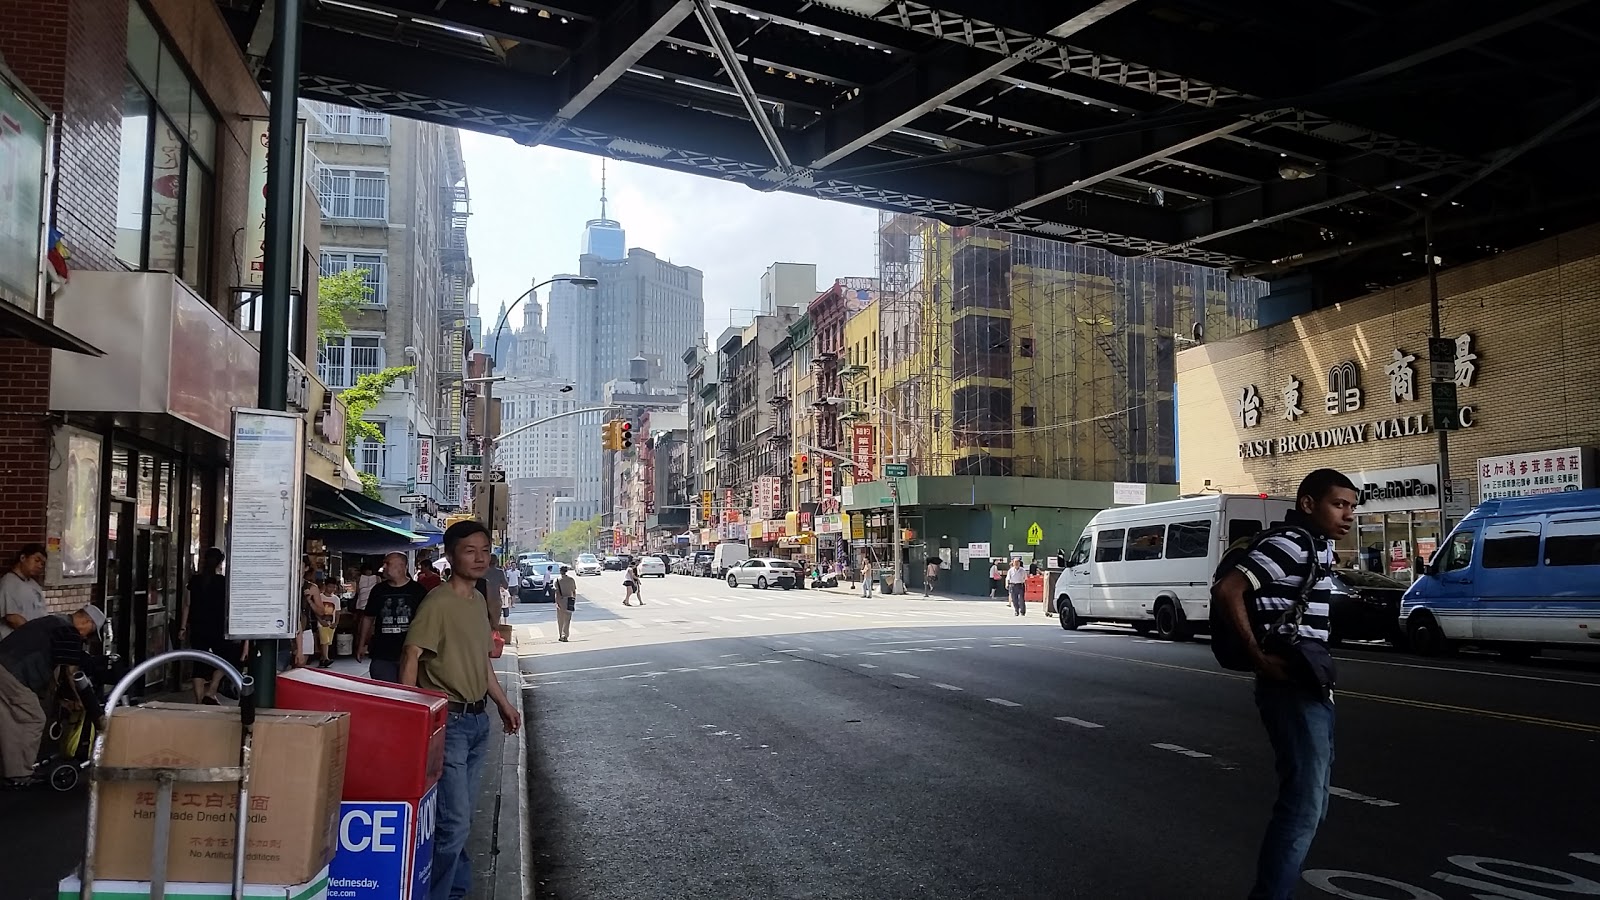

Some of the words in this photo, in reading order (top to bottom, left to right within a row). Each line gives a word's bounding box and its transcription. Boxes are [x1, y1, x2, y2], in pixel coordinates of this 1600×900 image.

[1239, 375, 1304, 428] 怡東
[1238, 440, 1273, 459] EAST
[1279, 423, 1366, 454] BROADWAY
[1373, 415, 1428, 440] MALL
[1364, 481, 1401, 500] Health
[1404, 479, 1431, 496] Plan
[197, 811, 225, 822] Dried
[229, 813, 267, 824] Nodle
[190, 850, 202, 858] No
